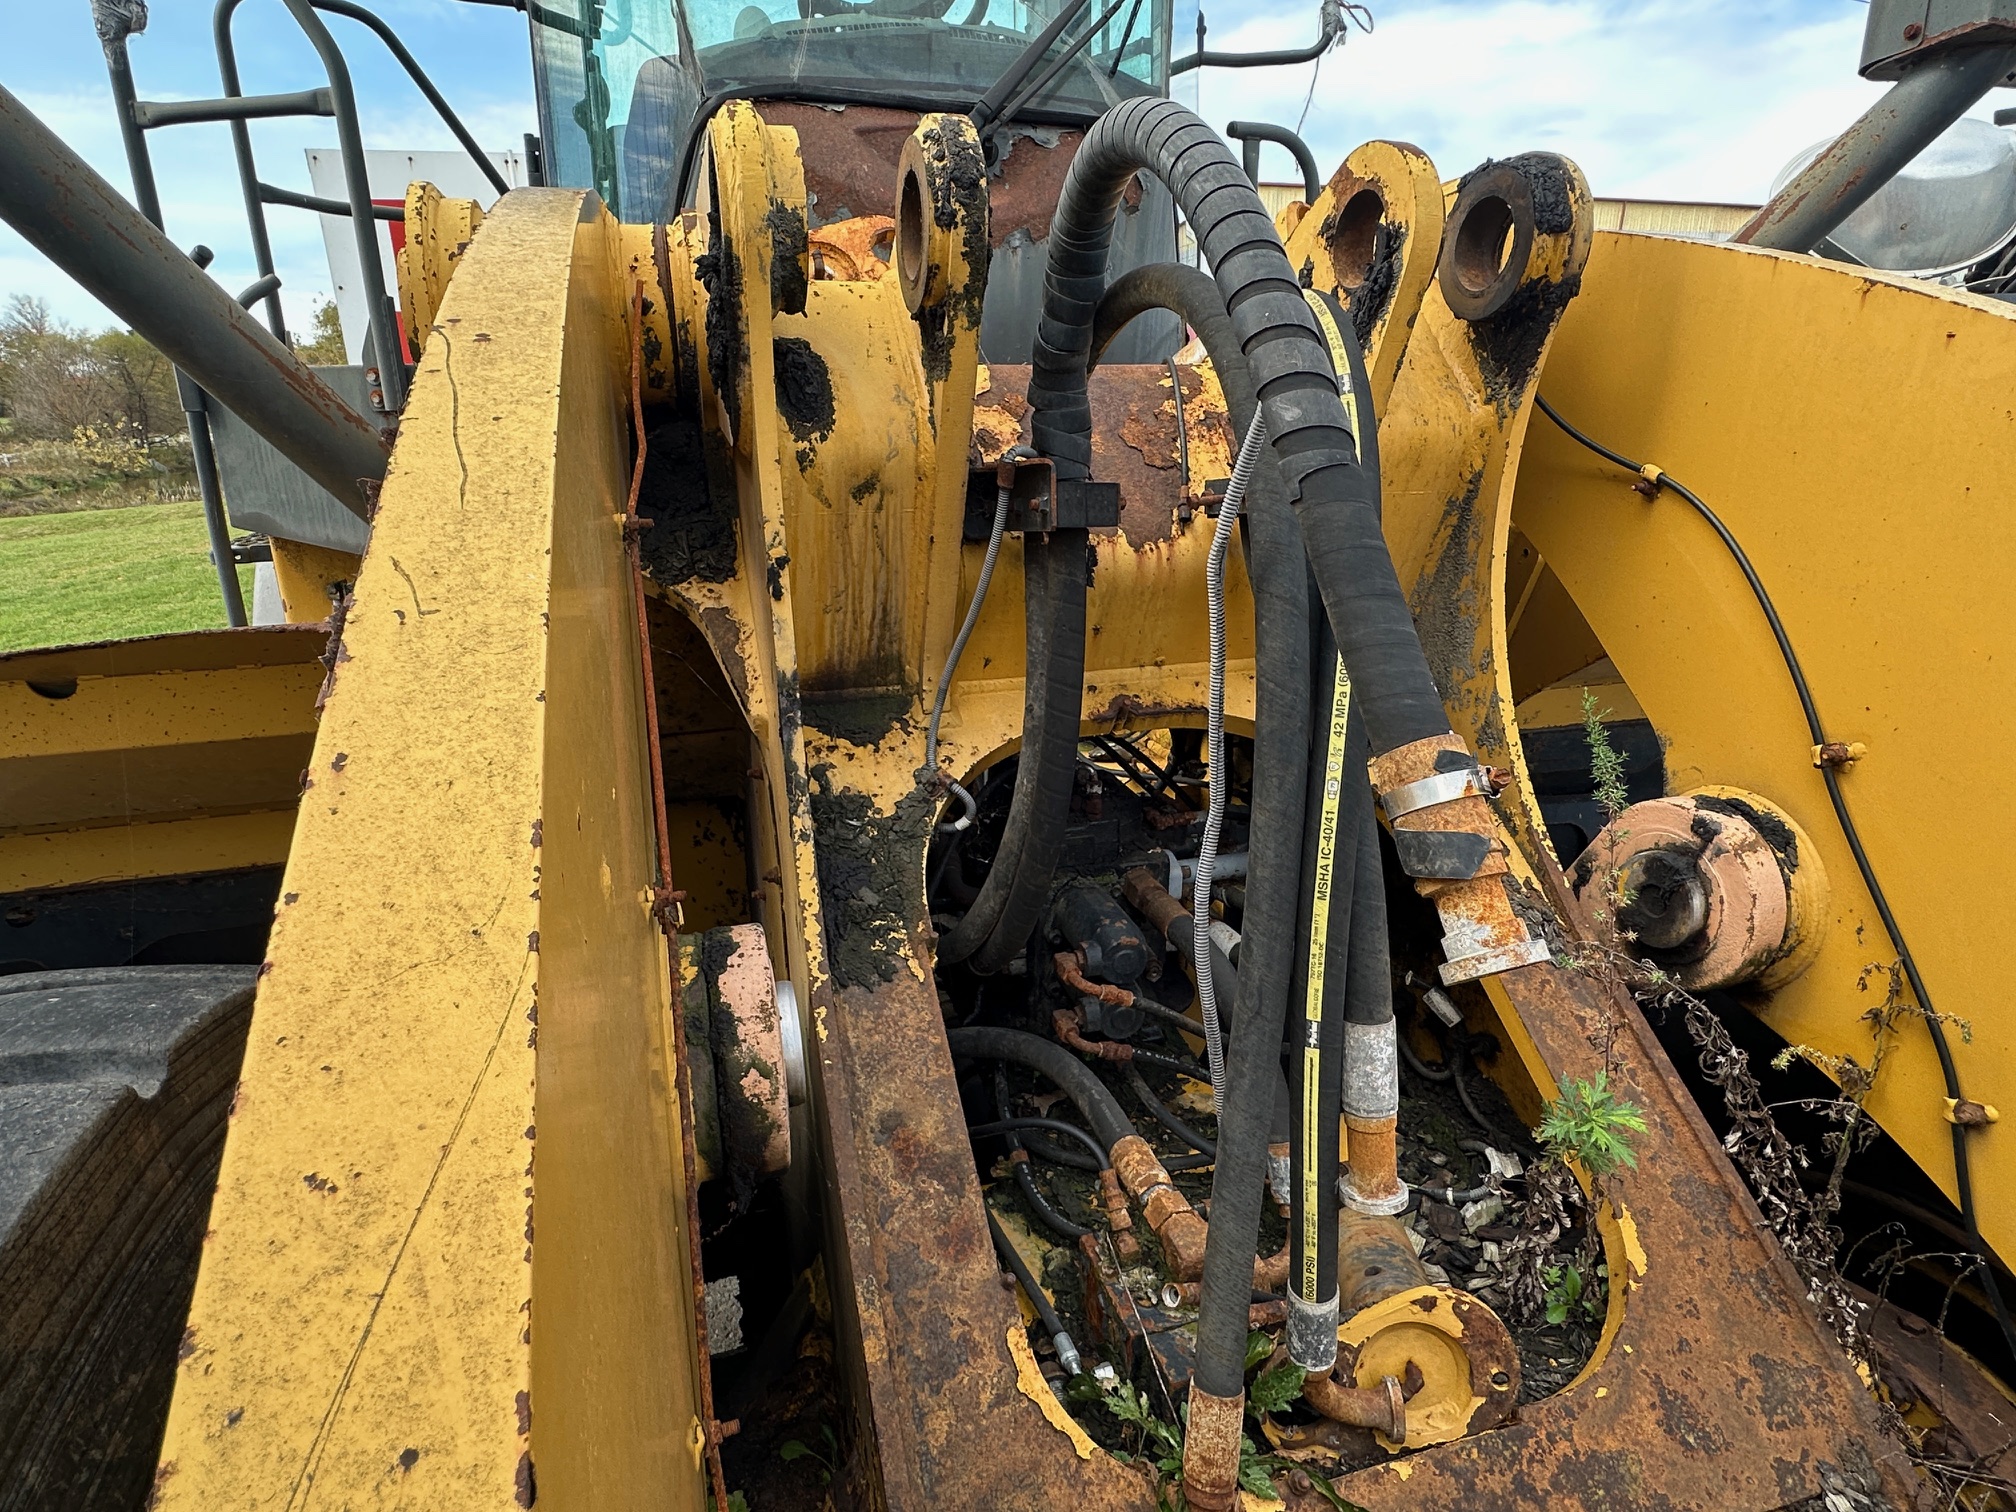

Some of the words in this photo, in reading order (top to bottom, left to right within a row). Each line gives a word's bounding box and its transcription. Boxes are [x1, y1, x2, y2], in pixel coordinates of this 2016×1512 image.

[1335, 691, 1347, 719] MPa
[1333, 722, 1344, 738] 42
[1320, 810, 1335, 860] IC-40/41
[1317, 863, 1330, 901] MSHA
[1305, 1256, 1316, 1275] PSI)
[1305, 1276, 1315, 1300] (6000
